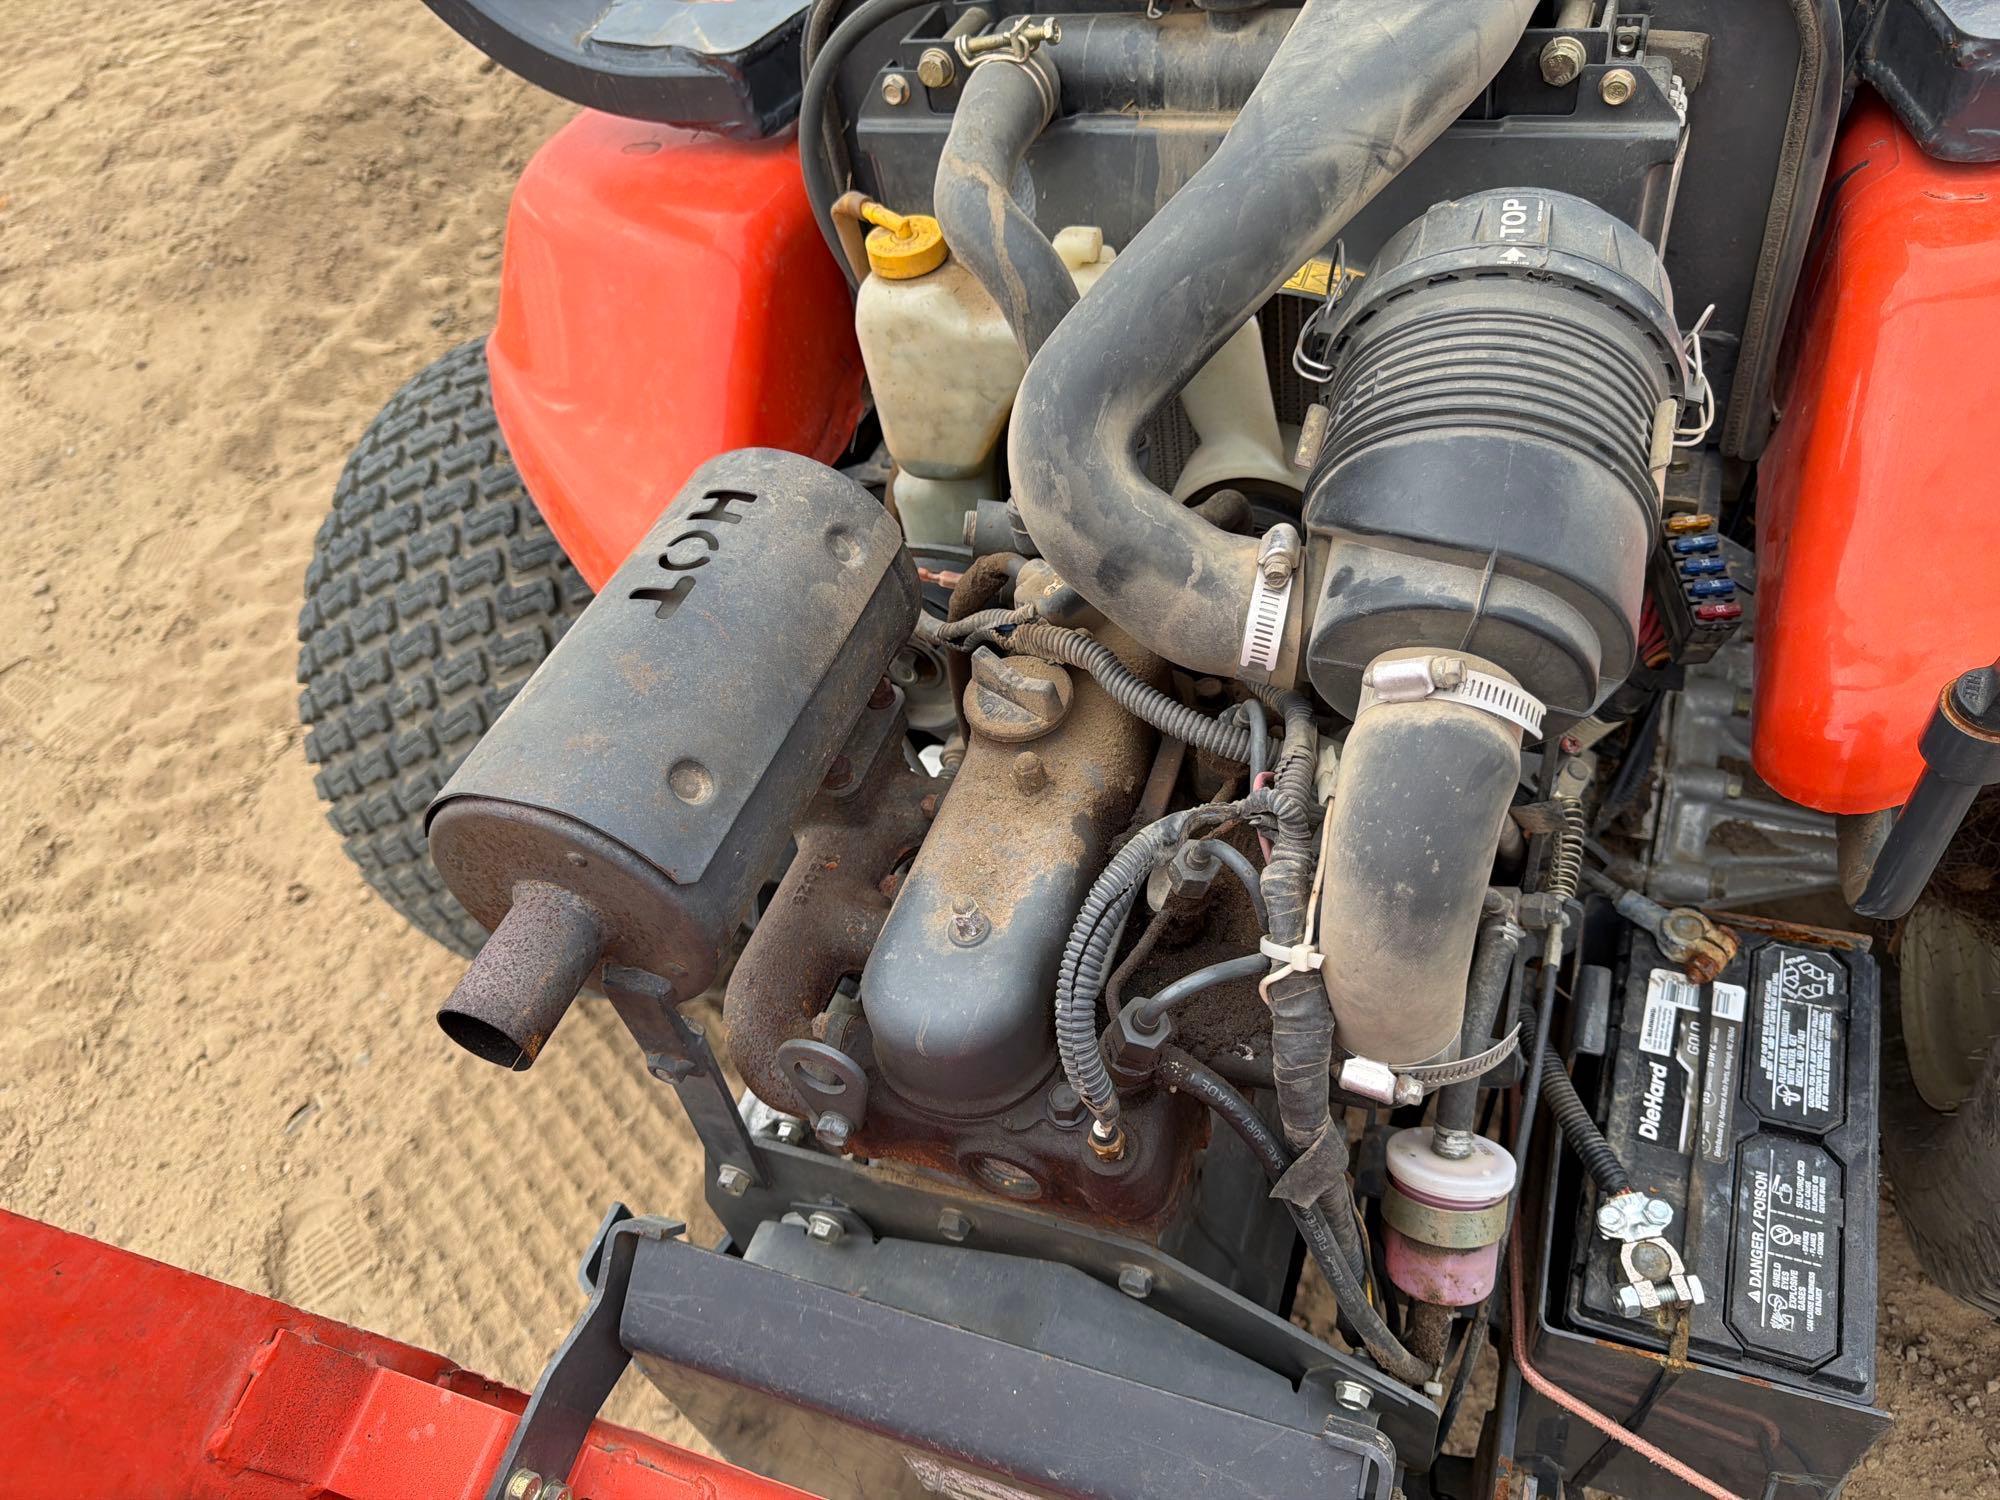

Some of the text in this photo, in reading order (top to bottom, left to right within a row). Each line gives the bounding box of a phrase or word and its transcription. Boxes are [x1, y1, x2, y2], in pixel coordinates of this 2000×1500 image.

[1499, 198, 1527, 238] TOP
[628, 490, 758, 619] HOT
[1779, 1009, 1790, 1048] IMMEDIATELY
[1788, 1034, 1797, 1047] GET
[1779, 1048, 1788, 1064] EYES
[1795, 1028, 1806, 1088] MEDICAL HELP FAST
[1778, 1064, 1787, 1084] FLUSH
[1787, 1070, 1796, 1085] WITH
[1200, 1077, 1238, 1112] MADE
[1638, 1062, 1668, 1141] DieHard
[1713, 1128, 1726, 1158] Distributed
[1720, 1085, 1730, 1097] Auto
[1264, 1145, 1286, 1170] SAE
[1753, 1170, 1768, 1220] POISON
[1796, 1160, 1806, 1208] SULFURIC ACID
[1794, 1234, 1802, 1246] NO
[1749, 1231, 1765, 1288] DANGER
[1772, 1262, 1781, 1288] SHIELD
[1781, 1270, 1790, 1290] EYES
[1789, 1269, 1799, 1309] EXPLOSIVE
[1808, 1271, 1816, 1301] BLINDNESS
[1797, 1286, 1806, 1311] GASES
